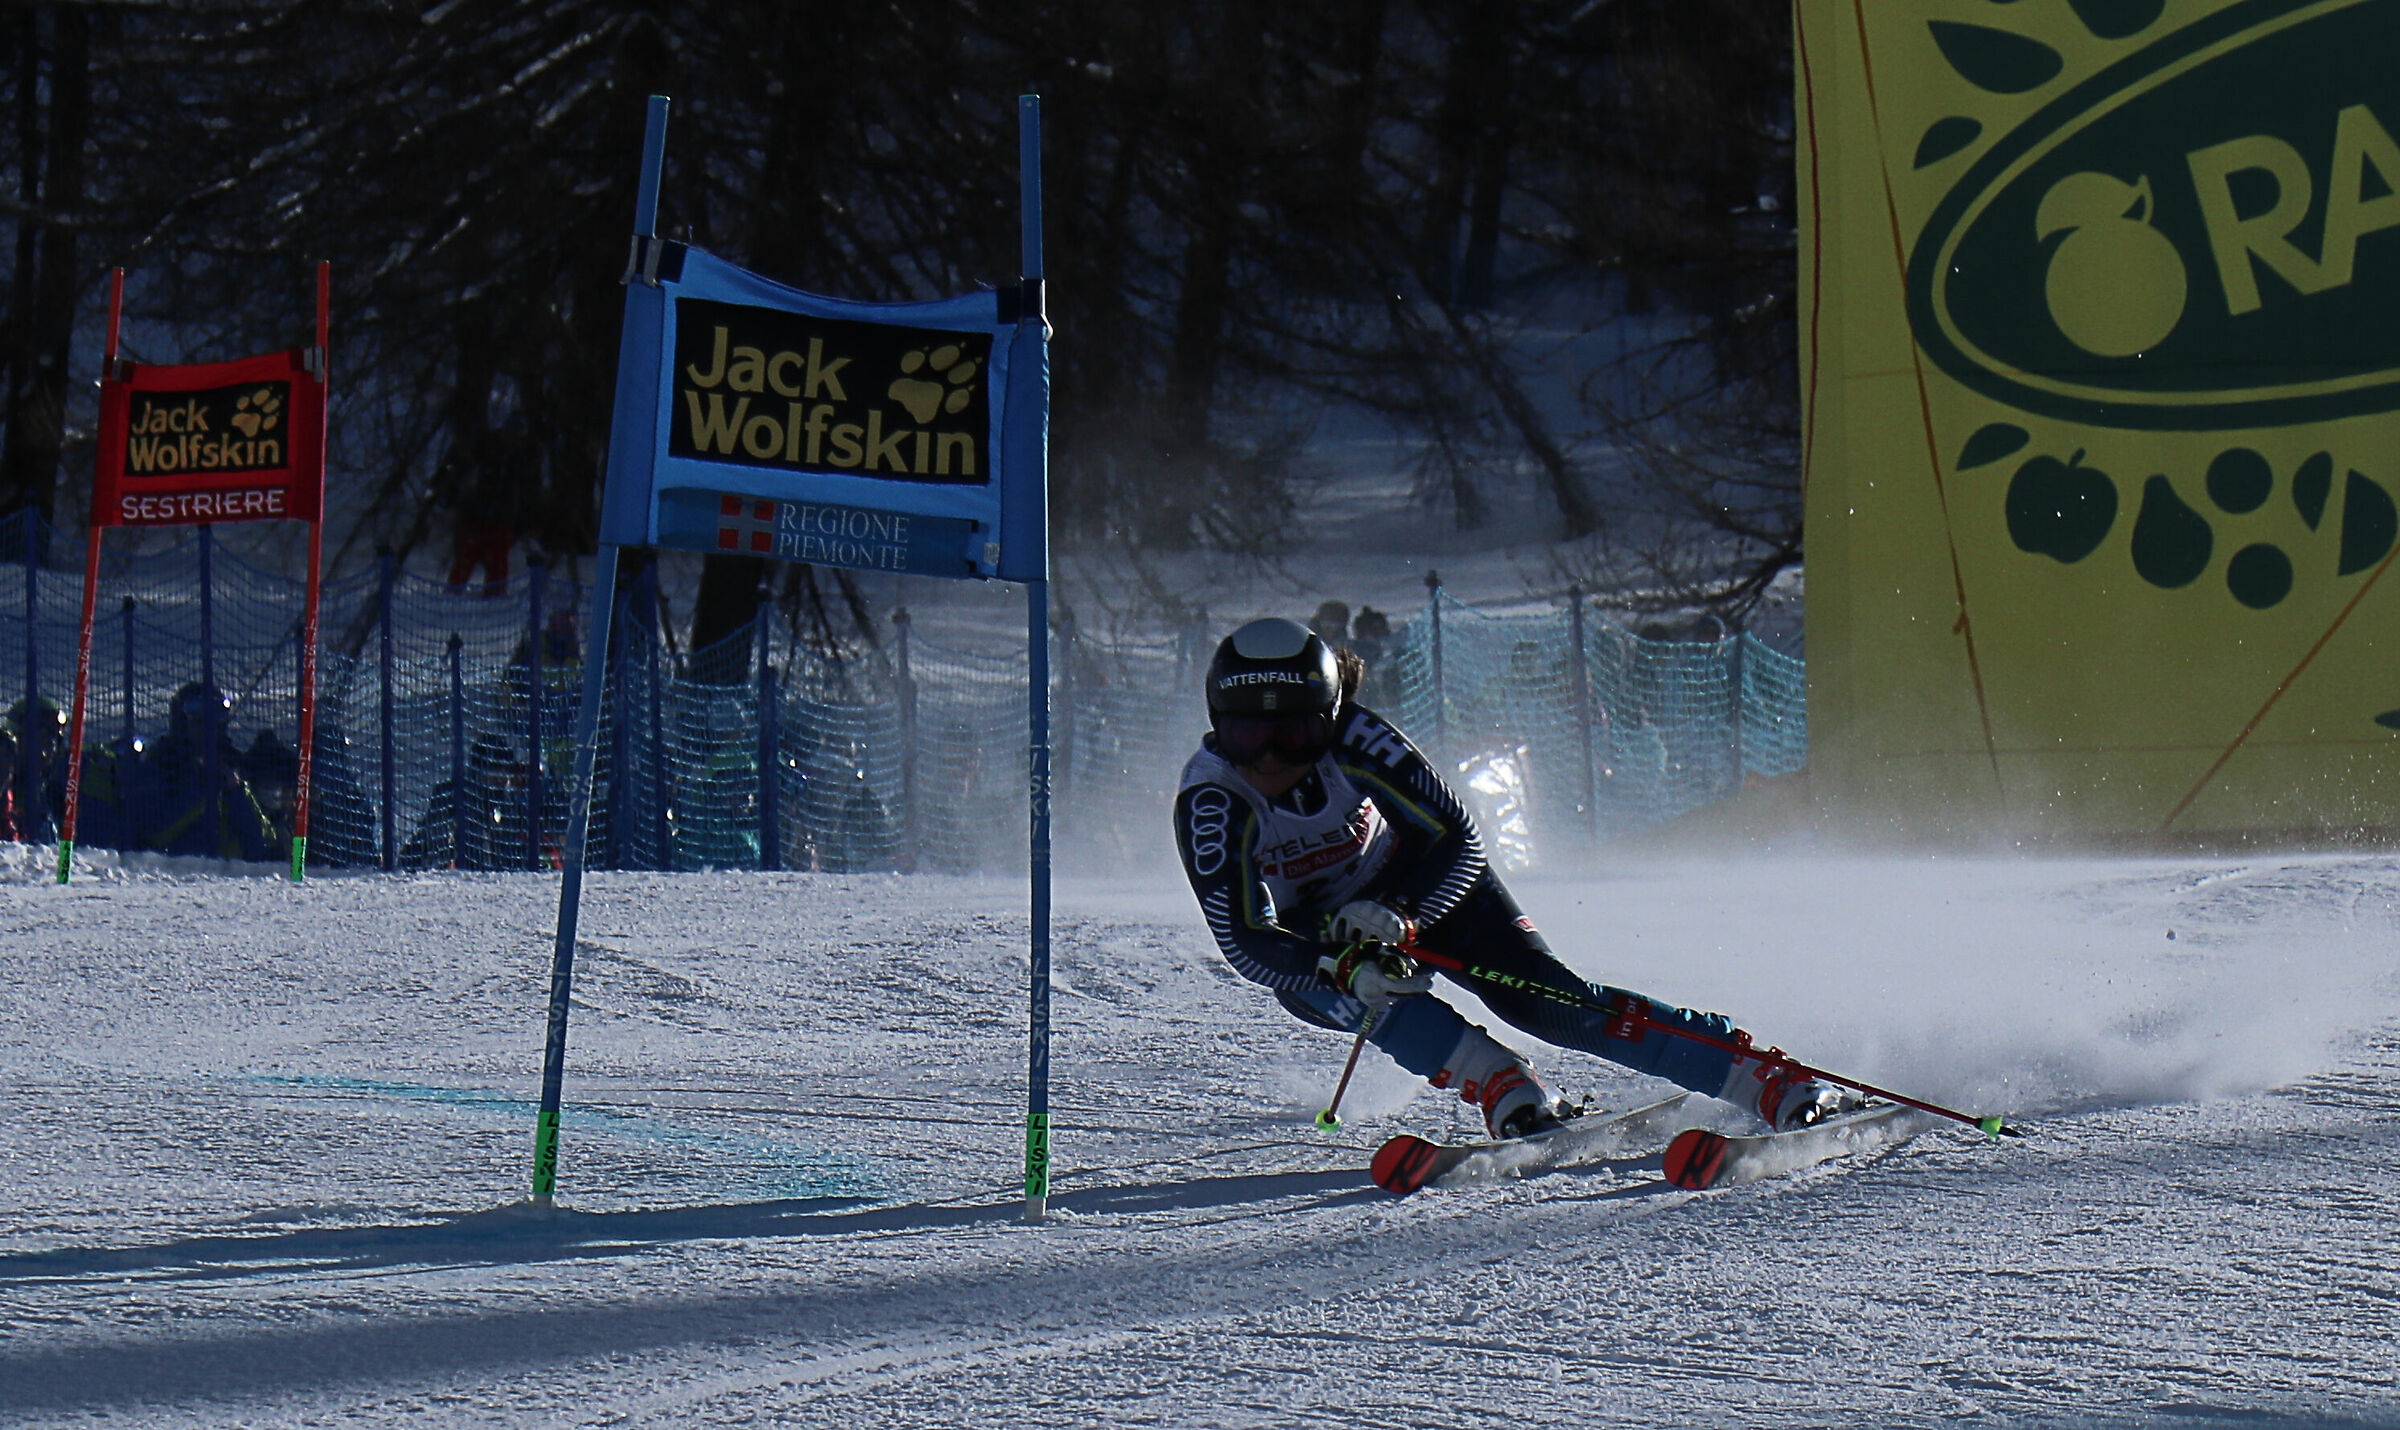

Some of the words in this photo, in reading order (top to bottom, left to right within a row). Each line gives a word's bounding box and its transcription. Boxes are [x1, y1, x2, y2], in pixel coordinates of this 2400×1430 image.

[686, 326, 854, 401] Jack
[131, 397, 210, 435] Jack
[684, 388, 977, 476] Wolfskin
[129, 432, 280, 472] Wolfskin
[121, 488, 285, 520] SESTRIERE
[781, 503, 910, 544] REGIONE
[779, 533, 907, 571] PIEMONTE
[1218, 671, 1304, 691] VATTENFALL
[1469, 965, 1526, 989] LEKI
[540, 1113, 559, 1193] LISKI
[1030, 1115, 1046, 1195] LISKI
